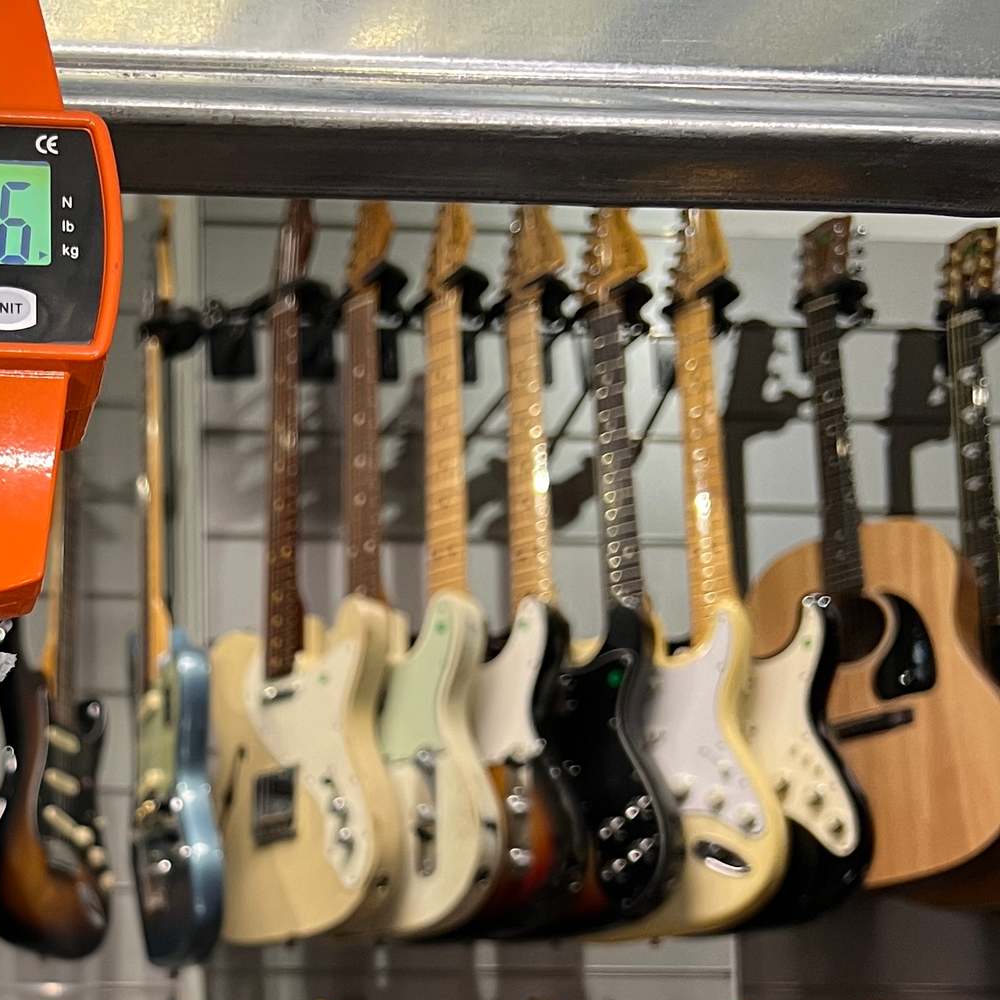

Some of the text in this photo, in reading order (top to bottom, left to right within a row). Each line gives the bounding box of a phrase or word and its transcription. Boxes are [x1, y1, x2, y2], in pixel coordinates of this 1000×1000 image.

[62, 196, 73, 209] N
[62, 220, 75, 233] lb
[62, 244, 79, 259] kg
